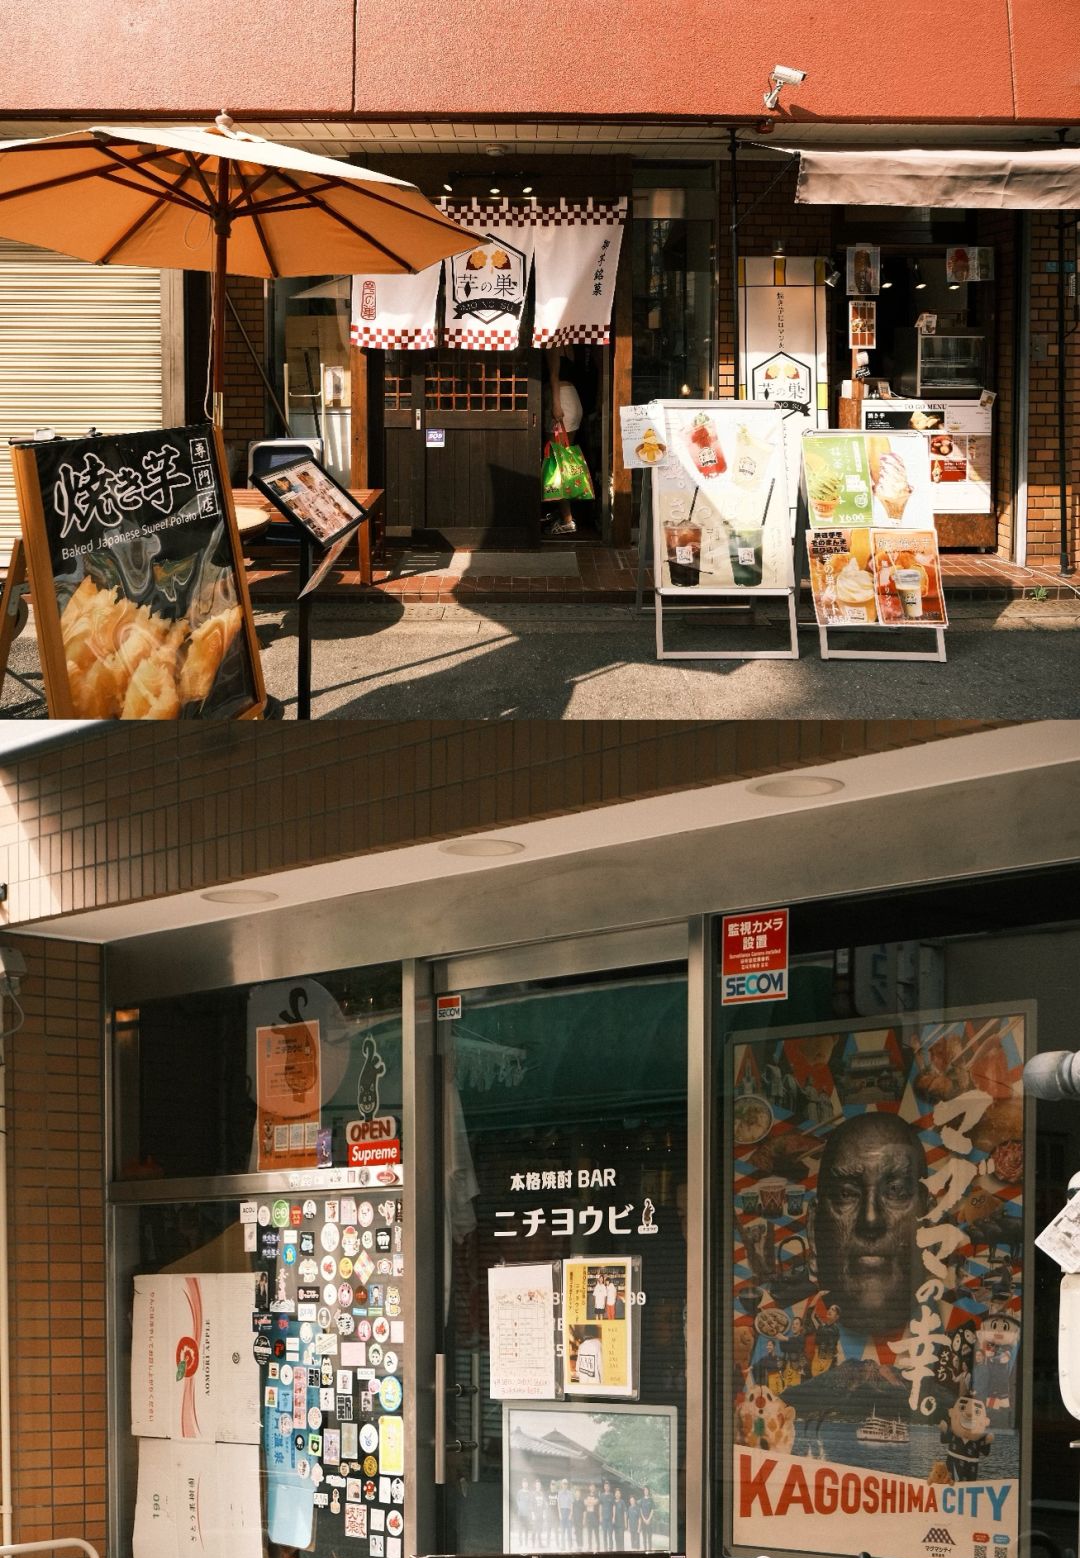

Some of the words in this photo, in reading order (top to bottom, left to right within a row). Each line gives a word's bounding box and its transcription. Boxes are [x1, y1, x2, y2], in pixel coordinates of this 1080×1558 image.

[458, 273, 517, 298] 芋の巣
[500, 301, 514, 312] SU
[192, 441, 216, 515] 専門店
[54, 444, 191, 538] 焼き芋
[62, 539, 94, 560] Baked
[97, 528, 140, 551] Japanese
[142, 519, 169, 535] Sweet
[170, 511, 197, 529] Potato
[728, 918, 784, 937] 監視カメラ
[743, 934, 768, 950] 設置
[726, 972, 784, 997] SECOM
[438, 1006, 460, 1017] SECOM
[350, 1119, 391, 1142] OPEN
[351, 1146, 398, 1165] Supreme
[510, 1170, 573, 1191] 本格焼酎
[577, 1168, 617, 1188] BAR
[493, 1203, 635, 1238] ニチヨウビ
[739, 1453, 938, 1518] KAGOSHIMA
[942, 1484, 1012, 1522] CITY
[152, 1493, 160, 1519] 190
[925, 1545, 952, 1554] マグマシティ
